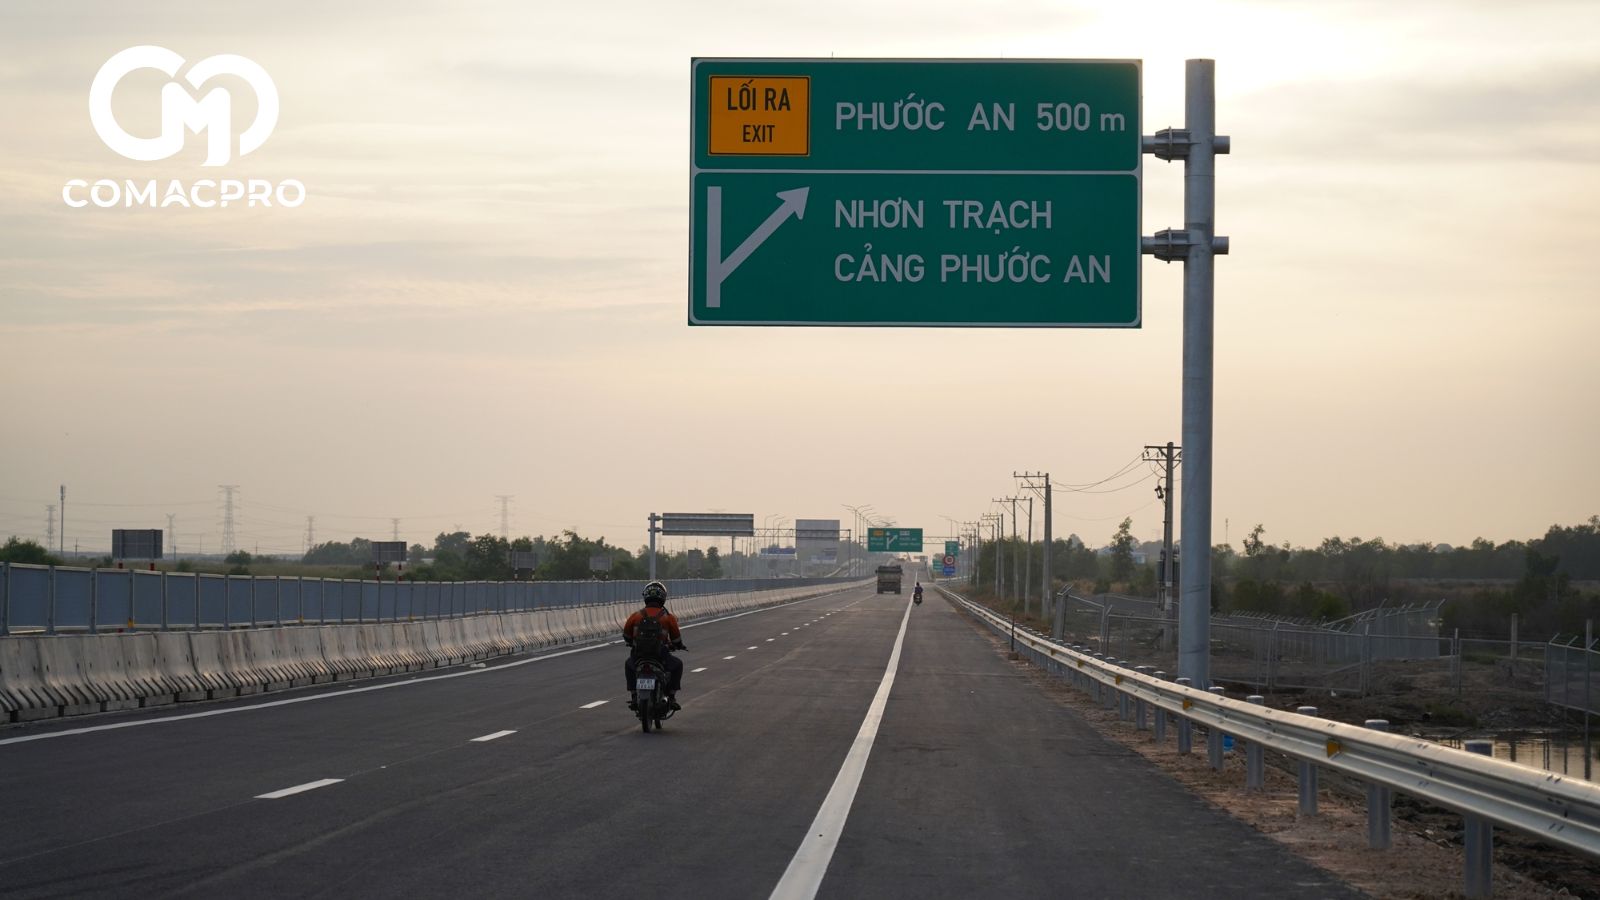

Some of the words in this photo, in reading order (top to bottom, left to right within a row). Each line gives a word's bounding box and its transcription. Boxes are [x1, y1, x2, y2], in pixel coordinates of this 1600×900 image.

[727, 80, 757, 111] LỐI
[764, 87, 791, 112] RA
[836, 92, 945, 131] PHƯỚC
[967, 102, 1015, 131] AN
[1037, 102, 1091, 131] 500
[1100, 113, 1126, 132] m
[742, 124, 776, 144] EXIT
[835, 197, 924, 228] NHƠN
[943, 199, 1052, 235] TRẠCH
[834, 242, 925, 283] CẢNG
[941, 245, 1051, 283] PHƯỚC
[1063, 255, 1111, 283] AN
